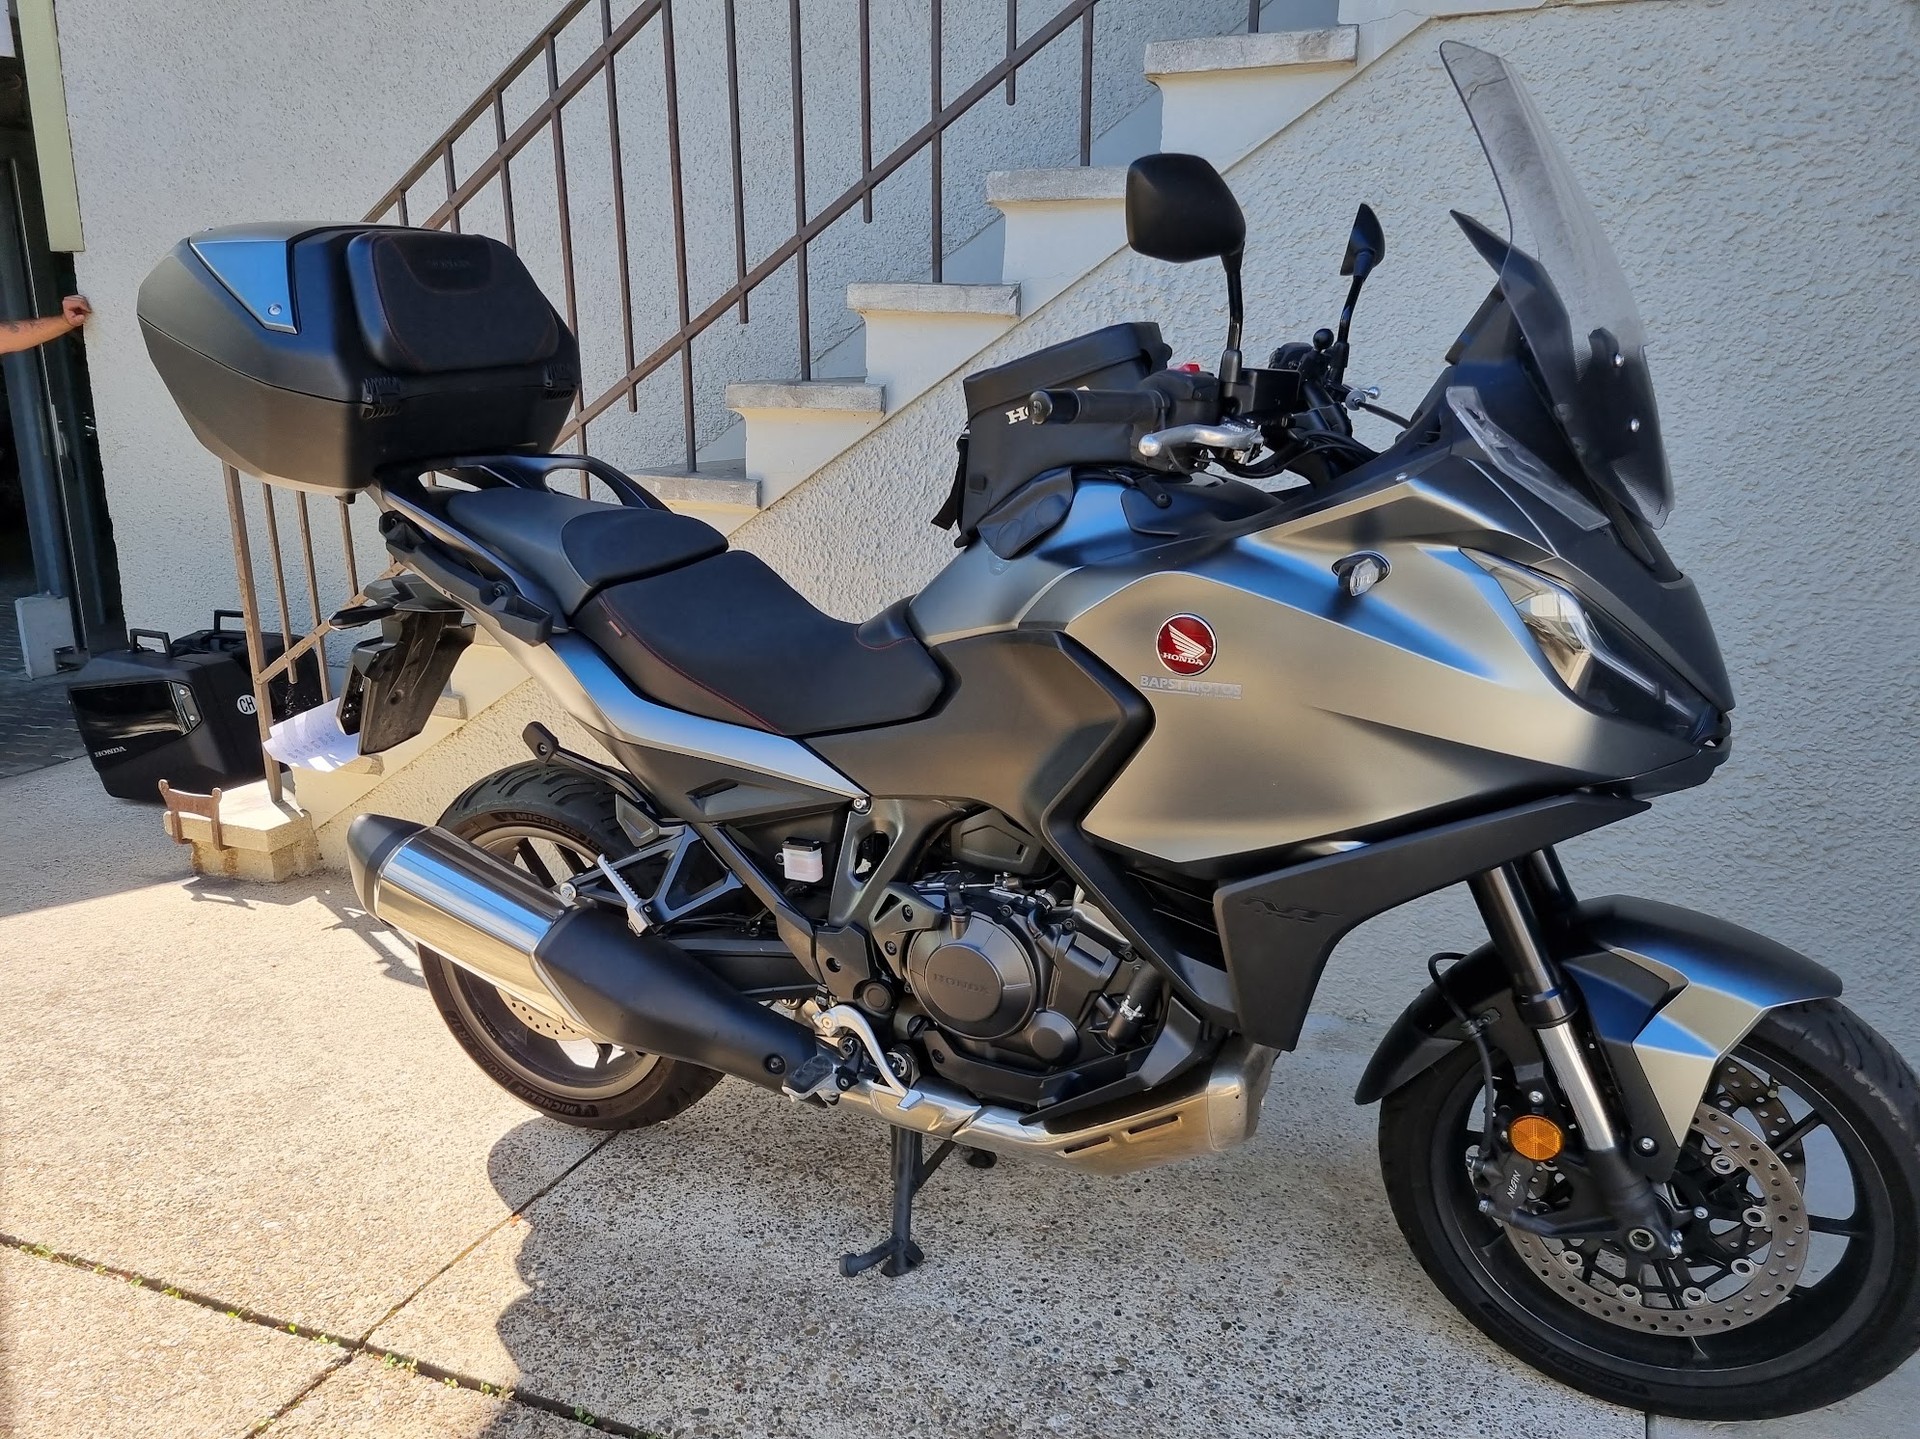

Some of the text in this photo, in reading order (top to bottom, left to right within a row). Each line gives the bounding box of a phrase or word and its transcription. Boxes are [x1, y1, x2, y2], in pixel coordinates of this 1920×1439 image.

[1163, 651, 1205, 667] HONDA
[1140, 675, 1183, 691] BAPST
[240, 696, 255, 713] CH
[94, 745, 127, 758] HONDA
[514, 811, 583, 838] MICHELIN
[933, 972, 993, 995] HONDA
[514, 1084, 579, 1116] MICHELIN
